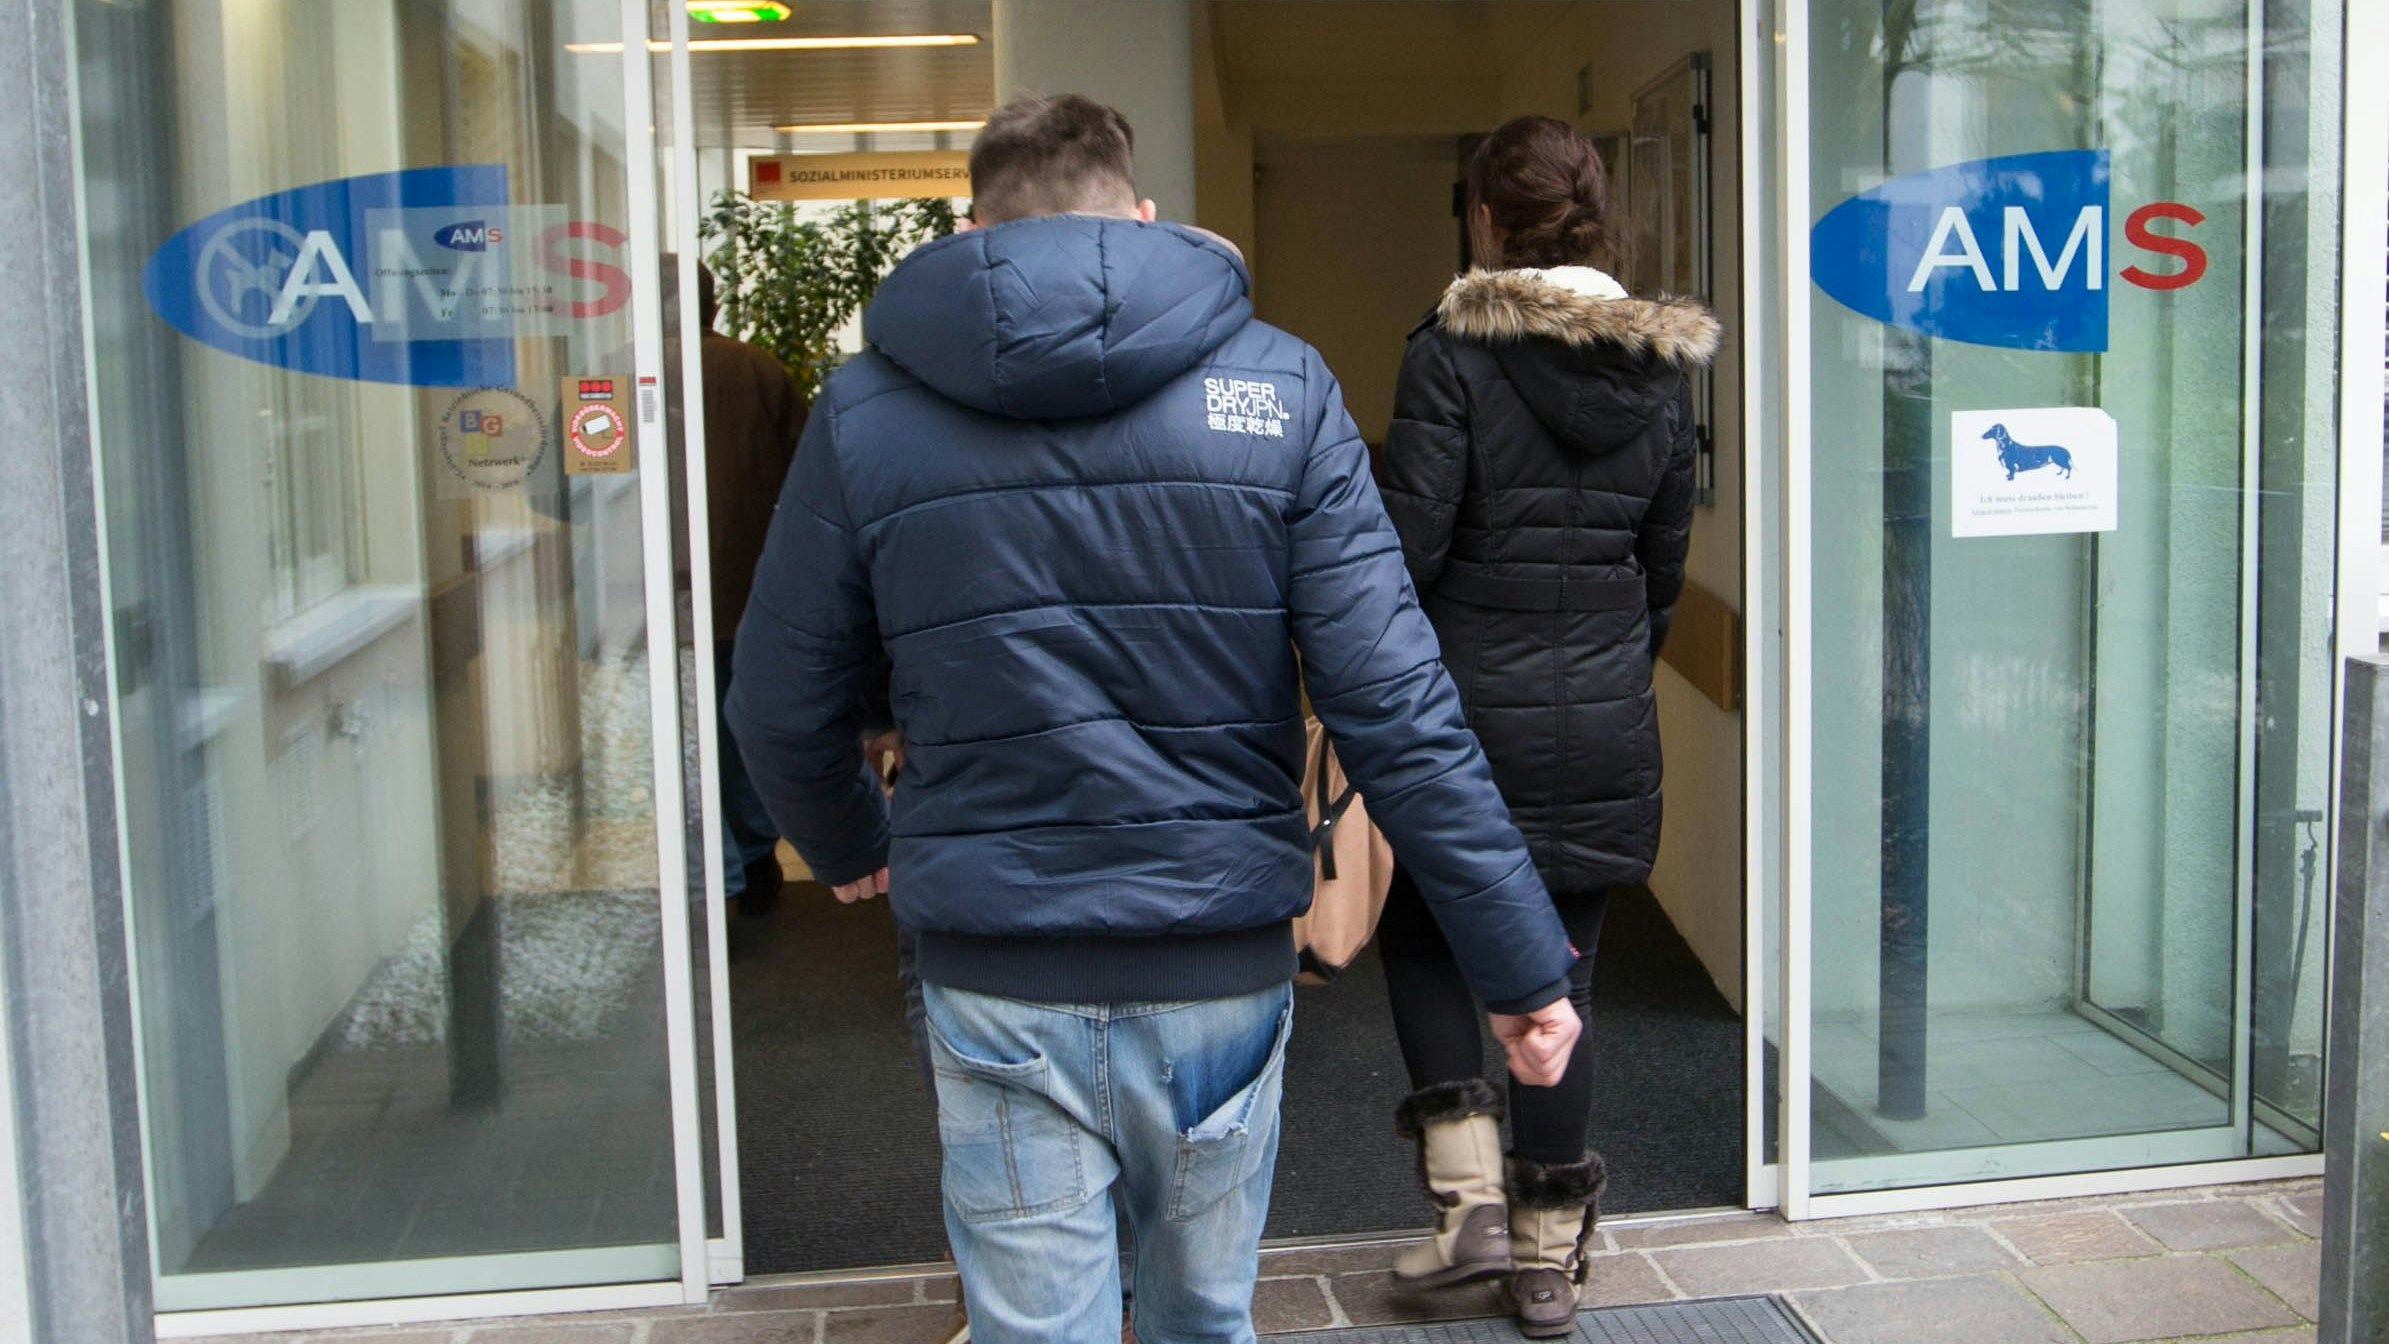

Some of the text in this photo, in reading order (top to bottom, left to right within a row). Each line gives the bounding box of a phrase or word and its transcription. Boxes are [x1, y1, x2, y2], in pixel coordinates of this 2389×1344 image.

[449, 228, 503, 244] AMS
[1906, 201, 2208, 291] AMS
[267, 220, 632, 325] AMS
[1204, 377, 1276, 401] SUPER
